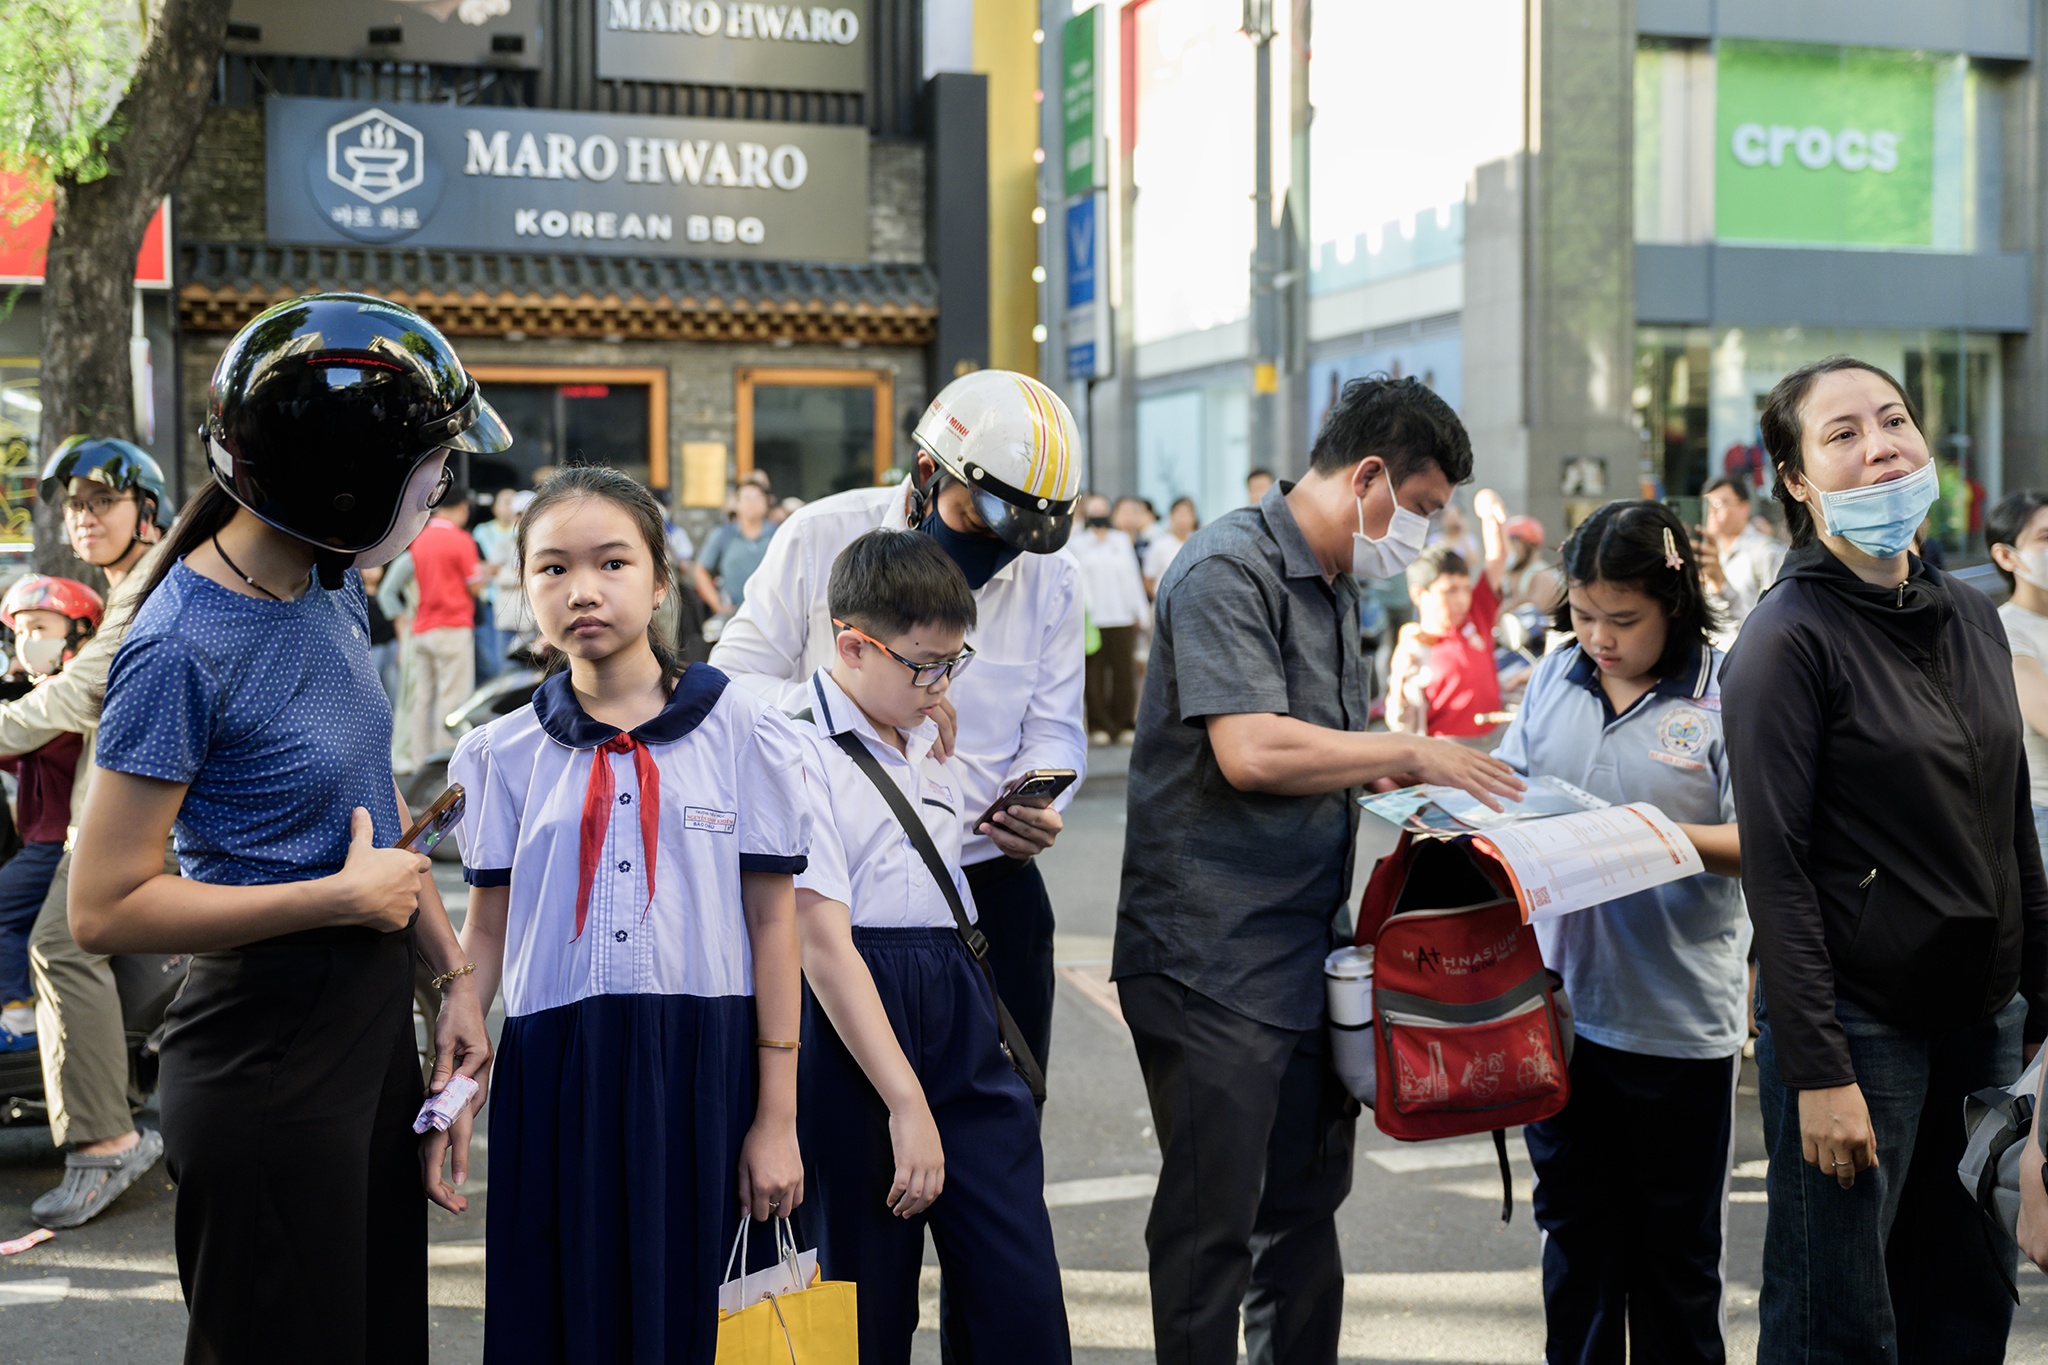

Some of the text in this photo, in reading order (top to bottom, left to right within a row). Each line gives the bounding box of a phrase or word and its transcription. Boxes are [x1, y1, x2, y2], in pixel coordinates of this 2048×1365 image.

[608, 0, 859, 45] MARO HWARO
[464, 128, 808, 190] MARO HWARO
[1731, 122, 1899, 173] crocs
[514, 208, 766, 244] KOREAN BBQ
[949, 416, 970, 437] MINH
